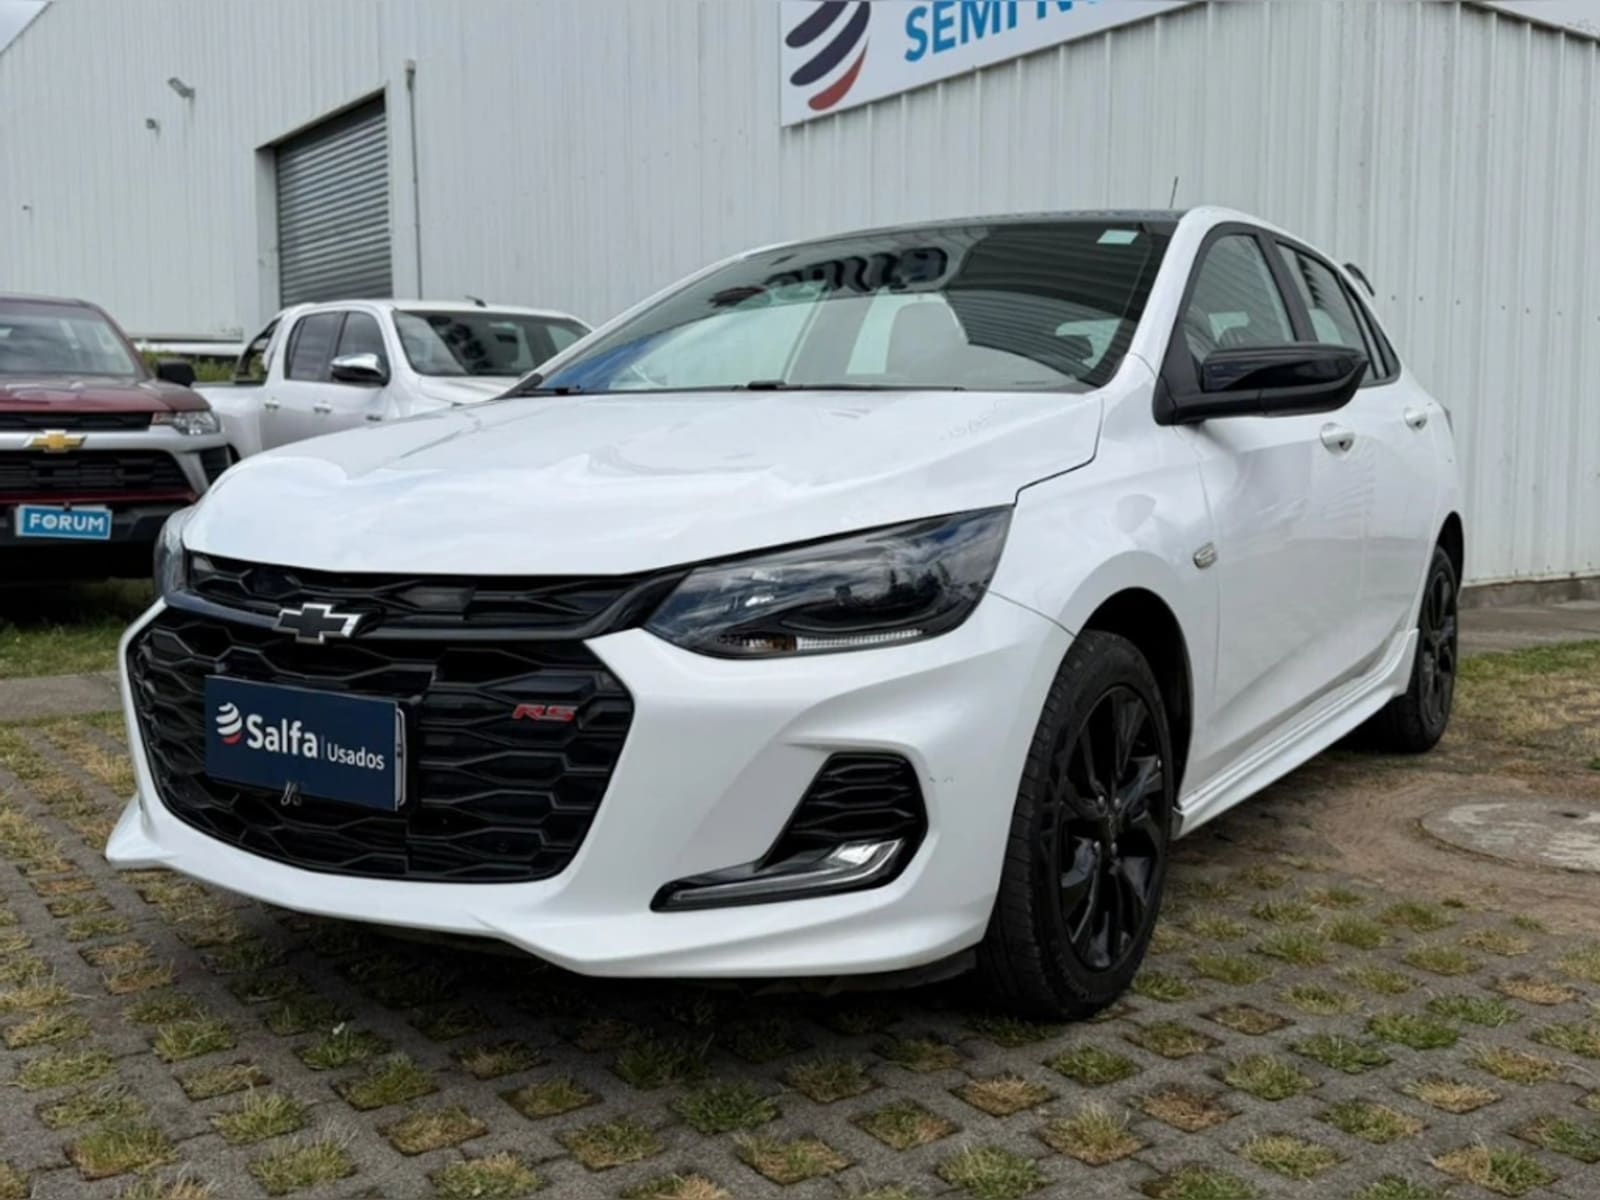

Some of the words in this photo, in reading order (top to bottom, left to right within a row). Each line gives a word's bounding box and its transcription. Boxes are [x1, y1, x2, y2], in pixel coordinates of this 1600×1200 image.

[29, 513, 105, 532] FORUM
[511, 703, 578, 721] RS
[246, 713, 318, 759] Salfa
[327, 742, 385, 770] Usados
